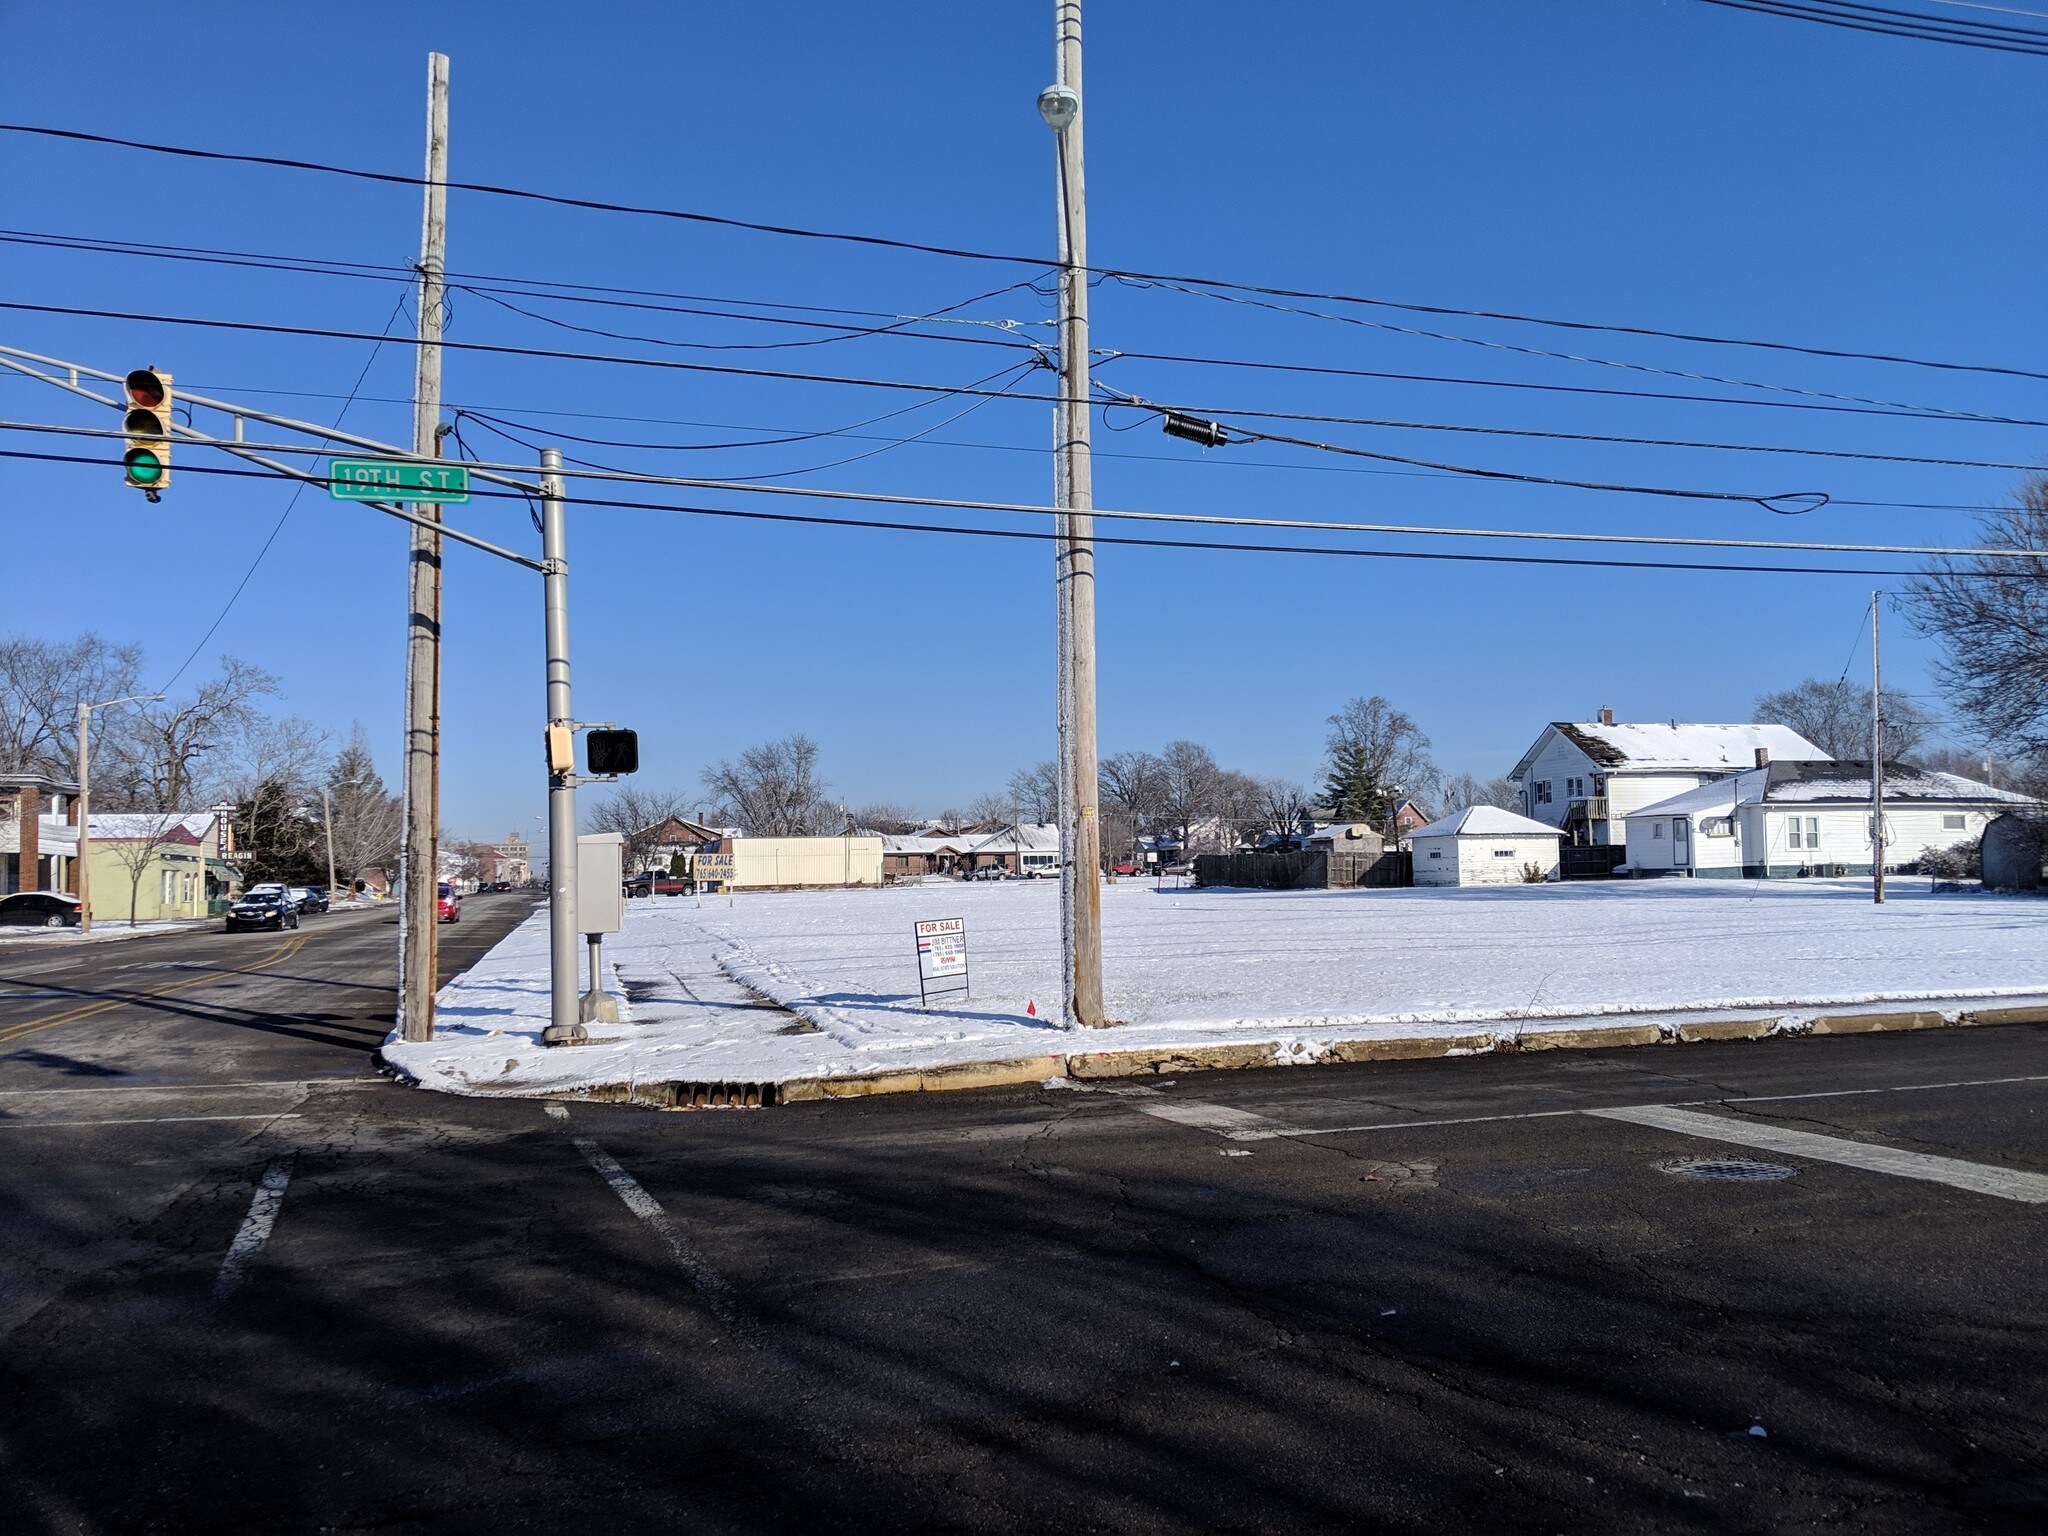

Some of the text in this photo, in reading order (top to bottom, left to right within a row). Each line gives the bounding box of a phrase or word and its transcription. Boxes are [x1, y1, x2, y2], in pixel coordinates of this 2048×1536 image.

[344, 468, 400, 493] 19TH
[698, 855, 733, 866] FOR SALE
[920, 921, 960, 933] FOR SALE
[940, 936, 963, 945] BITTNER
